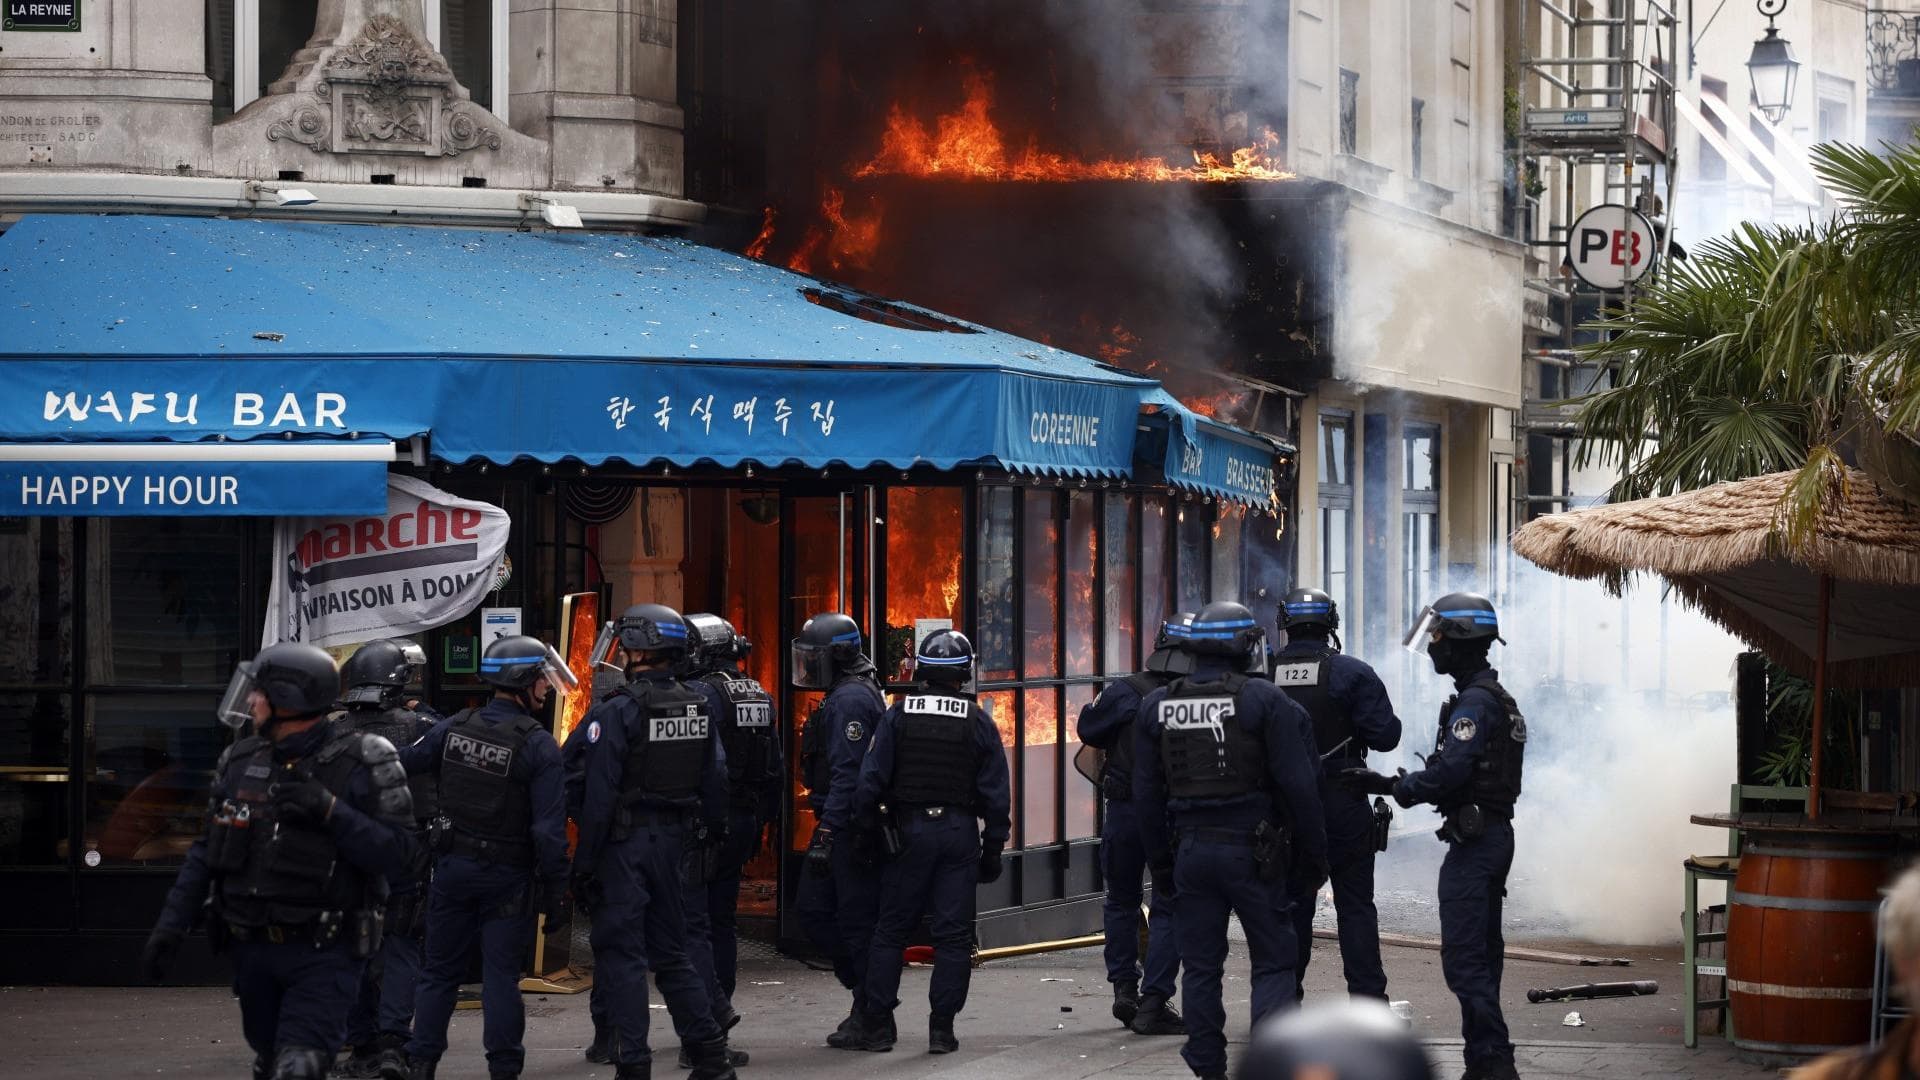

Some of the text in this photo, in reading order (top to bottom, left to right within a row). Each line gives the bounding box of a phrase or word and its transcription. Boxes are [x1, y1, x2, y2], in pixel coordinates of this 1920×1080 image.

[11, 4, 72, 16] LA REYNIE
[1579, 228, 1641, 266] PB
[233, 392, 347, 427] BAR
[1030, 411, 1100, 447] COREENNE
[1181, 447, 1203, 476] BAR
[21, 476, 239, 505] HAPPY HOUR
[1285, 669, 1309, 680] 122
[738, 706, 753, 723] TX
[908, 698, 926, 710] TR
[1164, 702, 1231, 725] POLICE
[656, 718, 706, 738] POLICE
[449, 736, 509, 766] POLICE
